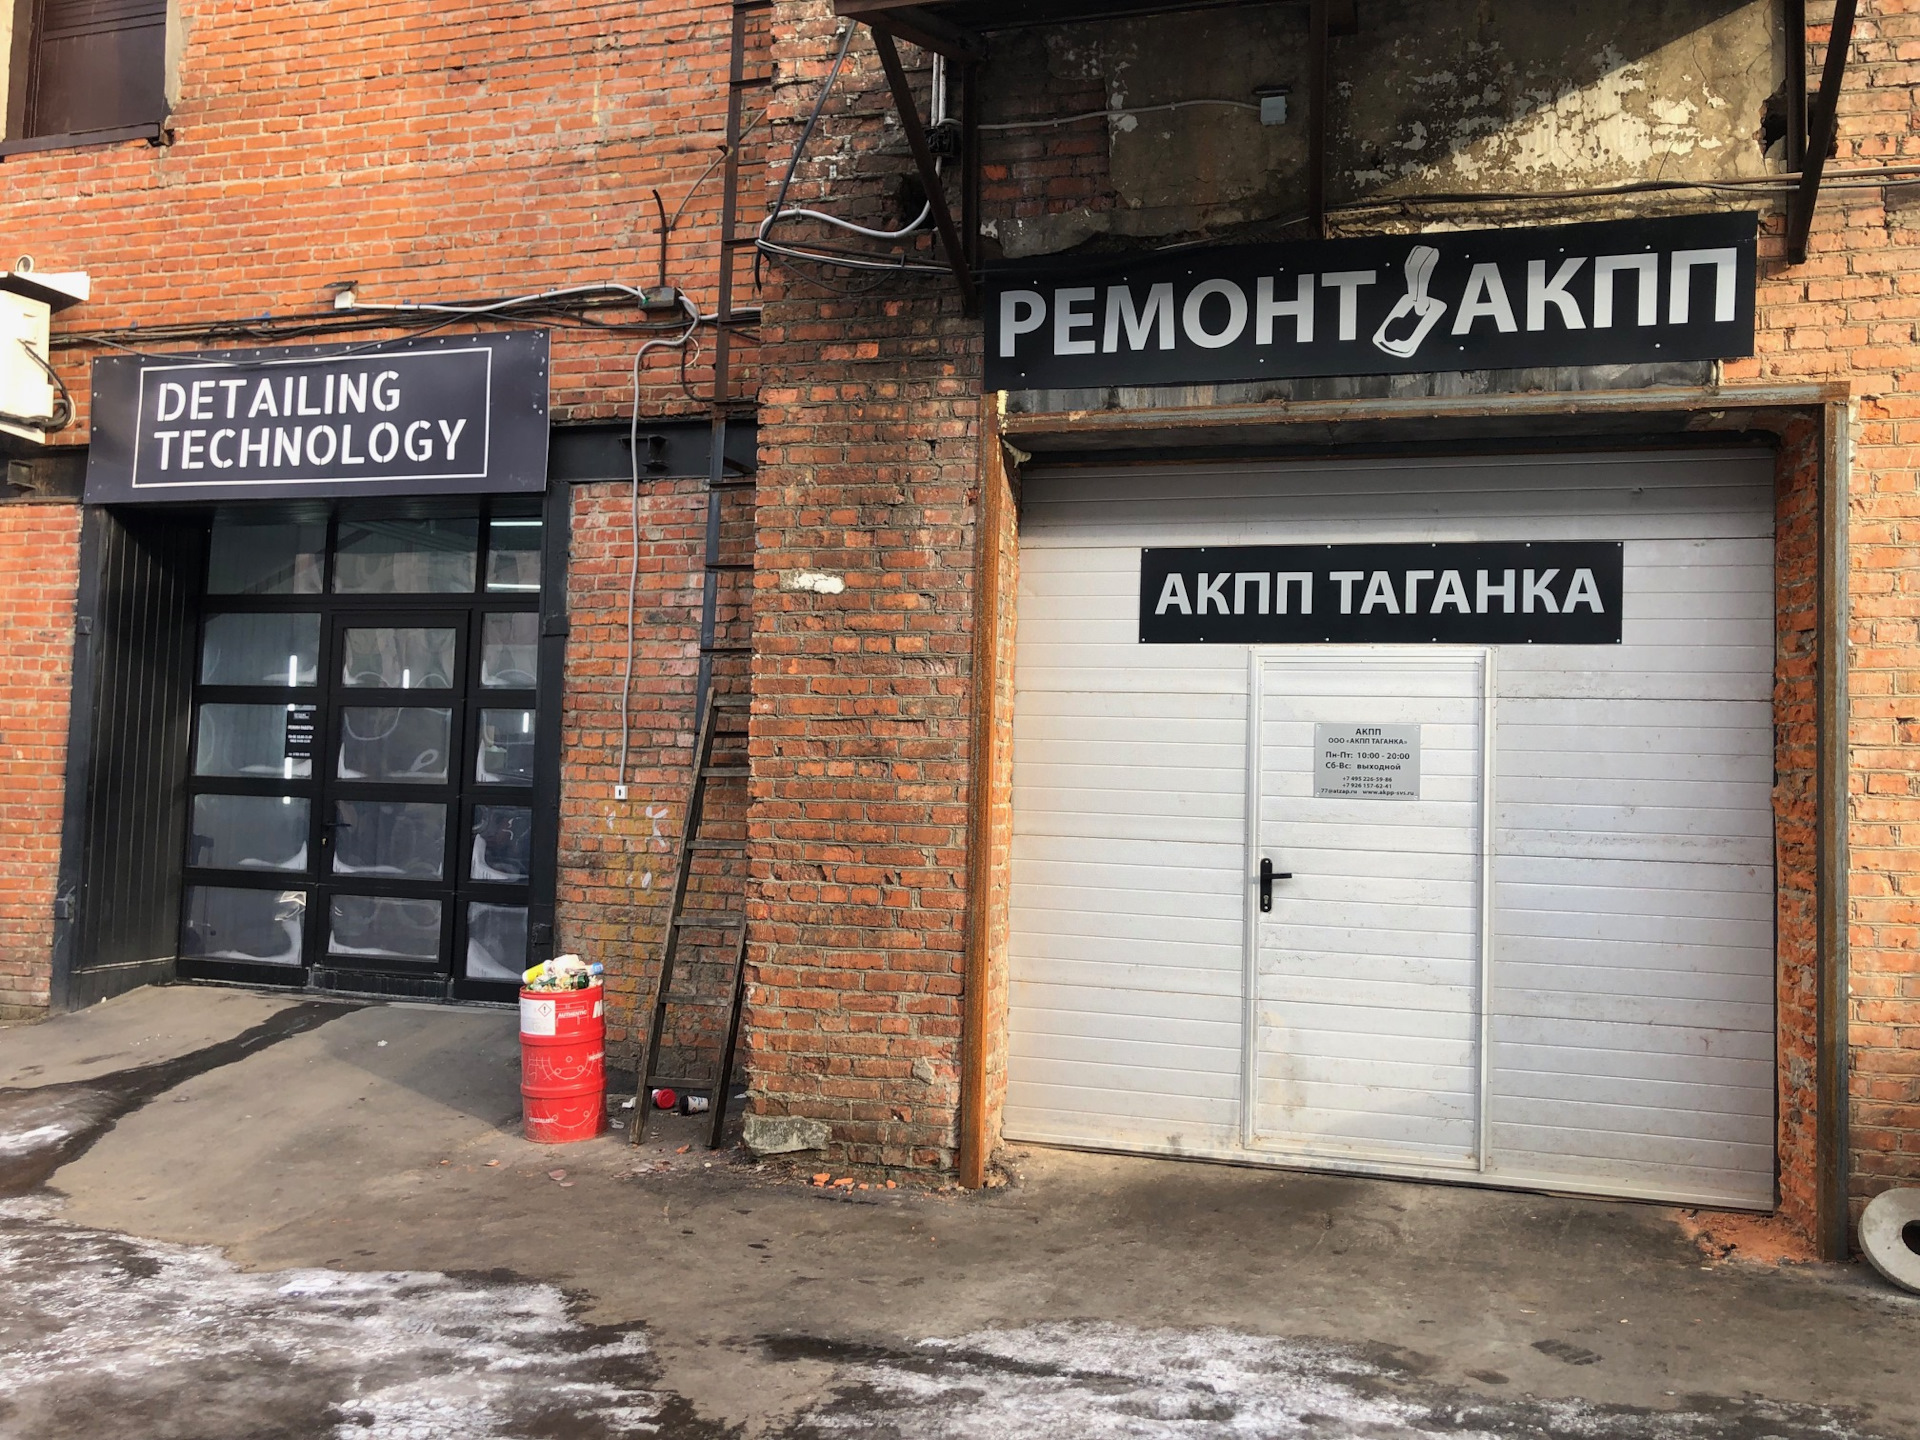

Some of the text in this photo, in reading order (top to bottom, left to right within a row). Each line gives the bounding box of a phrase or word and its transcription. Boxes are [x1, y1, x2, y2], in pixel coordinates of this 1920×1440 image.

[999, 246, 1738, 358] РЕМОНТ АКПП
[156, 370, 401, 422] DETAILING
[153, 418, 467, 471] TECHNOLOGY
[1154, 568, 1605, 615] АКПП ТАГАНКА
[1325, 751, 1354, 759] Пн-Пт:
[1386, 752, 1410, 760] 20:00
[1355, 728, 1382, 736] АКПП
[1356, 763, 1401, 771] выходной
